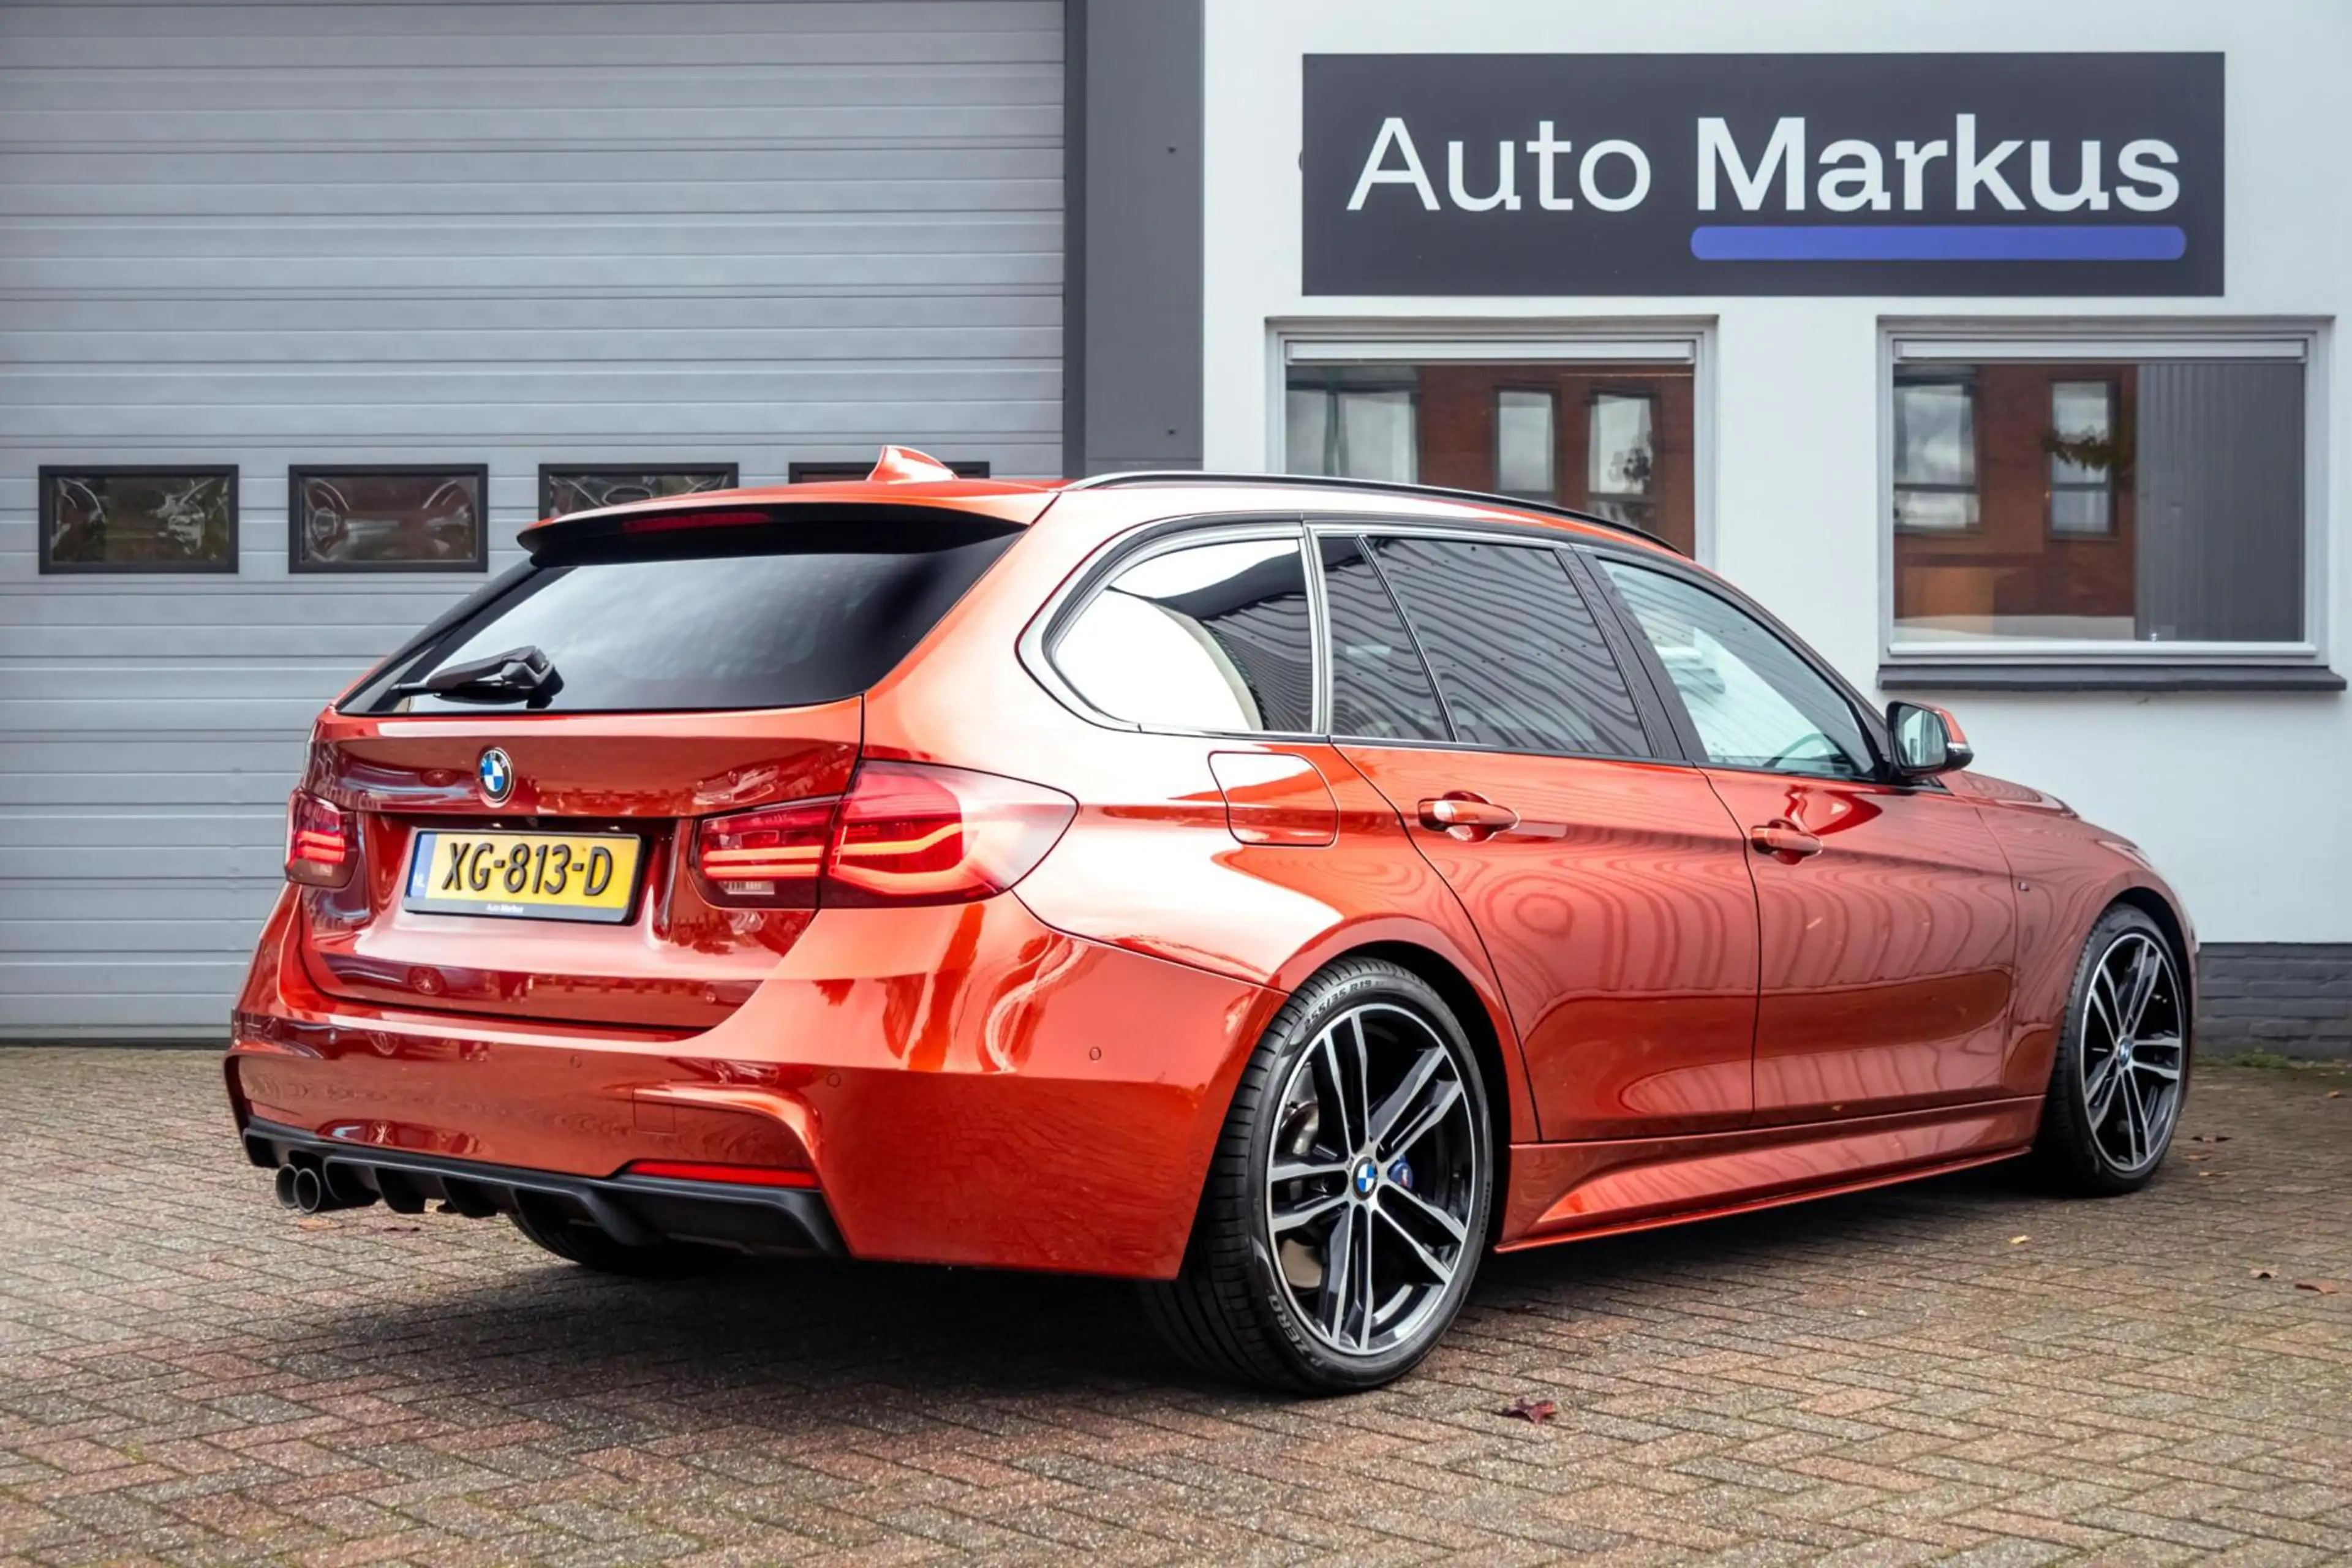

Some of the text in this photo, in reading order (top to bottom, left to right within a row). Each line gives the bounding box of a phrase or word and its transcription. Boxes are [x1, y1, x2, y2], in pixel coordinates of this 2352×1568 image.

[1347, 113, 2180, 212] Auto Markus
[442, 842, 613, 897] XG-813-D
[1303, 979, 1372, 1031] 255/35 R19
